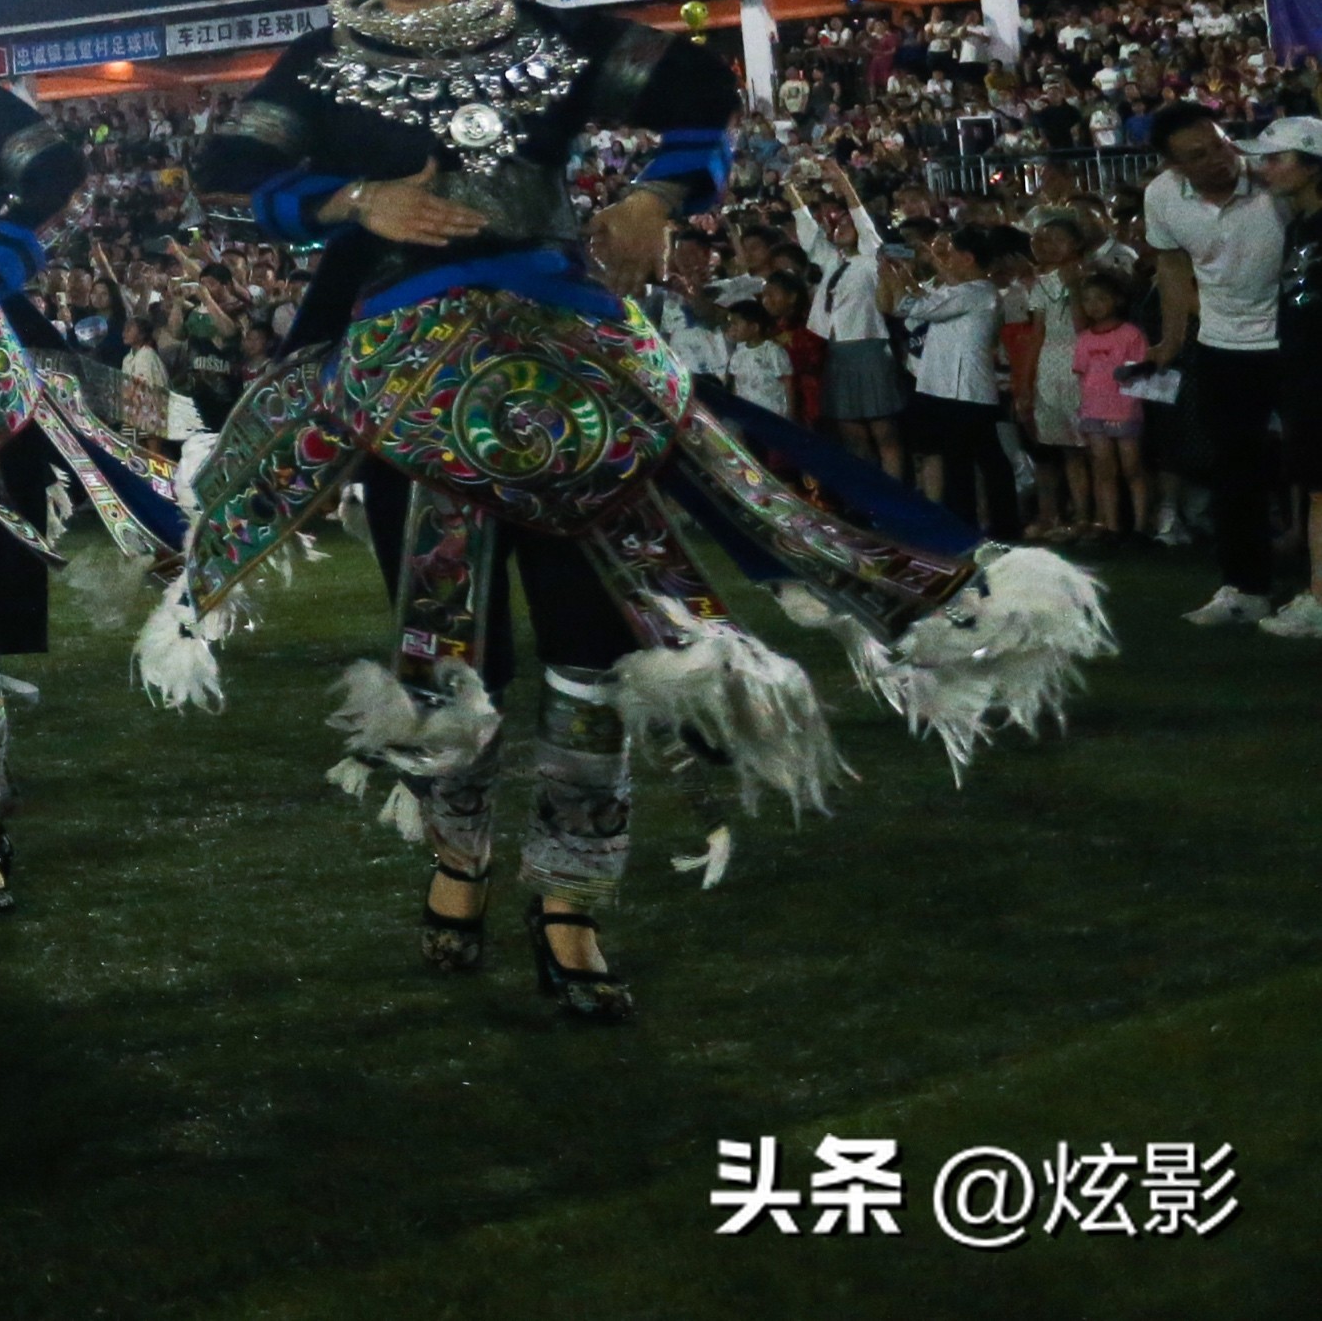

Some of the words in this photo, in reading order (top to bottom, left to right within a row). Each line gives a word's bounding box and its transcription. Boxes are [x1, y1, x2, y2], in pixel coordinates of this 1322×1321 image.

[178, 11, 315, 48] 车江口寨足球队
